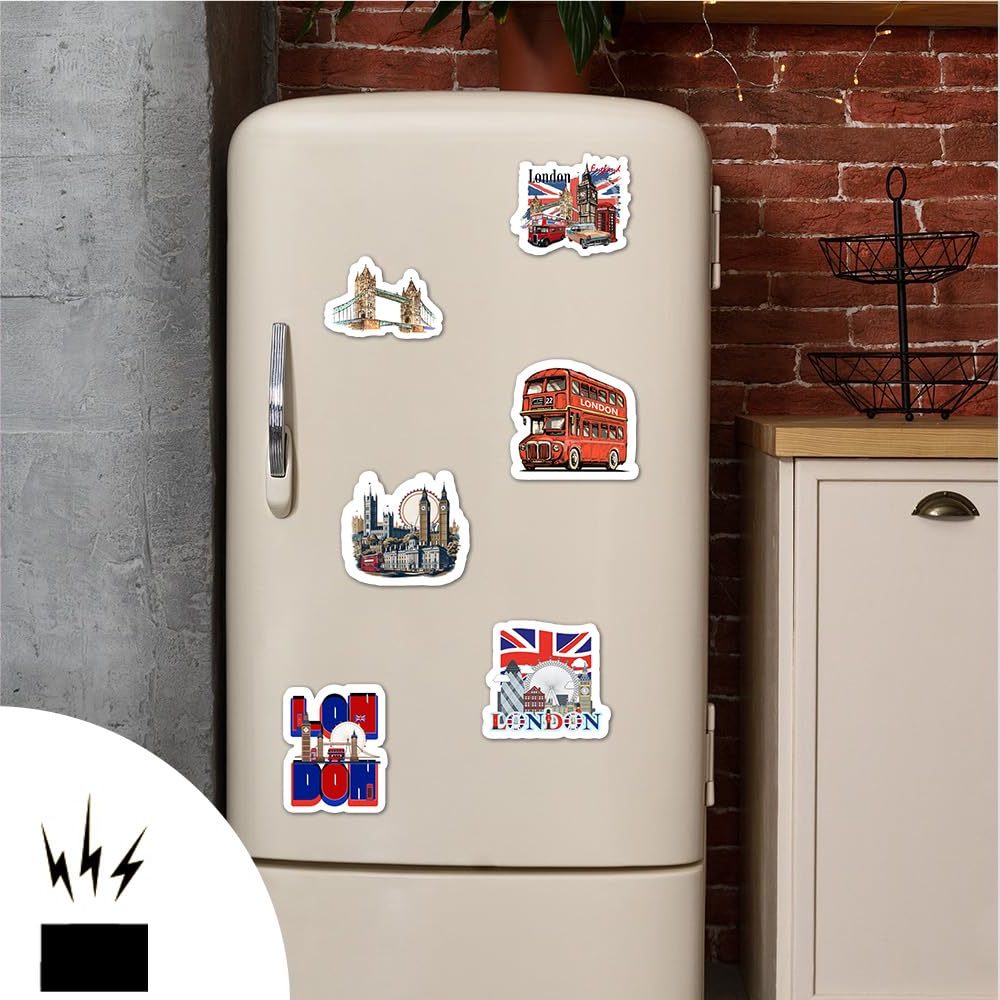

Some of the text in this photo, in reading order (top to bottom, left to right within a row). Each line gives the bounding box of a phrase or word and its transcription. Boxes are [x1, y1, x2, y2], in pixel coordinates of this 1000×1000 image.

[528, 168, 571, 183] London
[580, 398, 619, 416] LONDON
[491, 712, 601, 731] LONDON
[291, 760, 378, 807] DON
